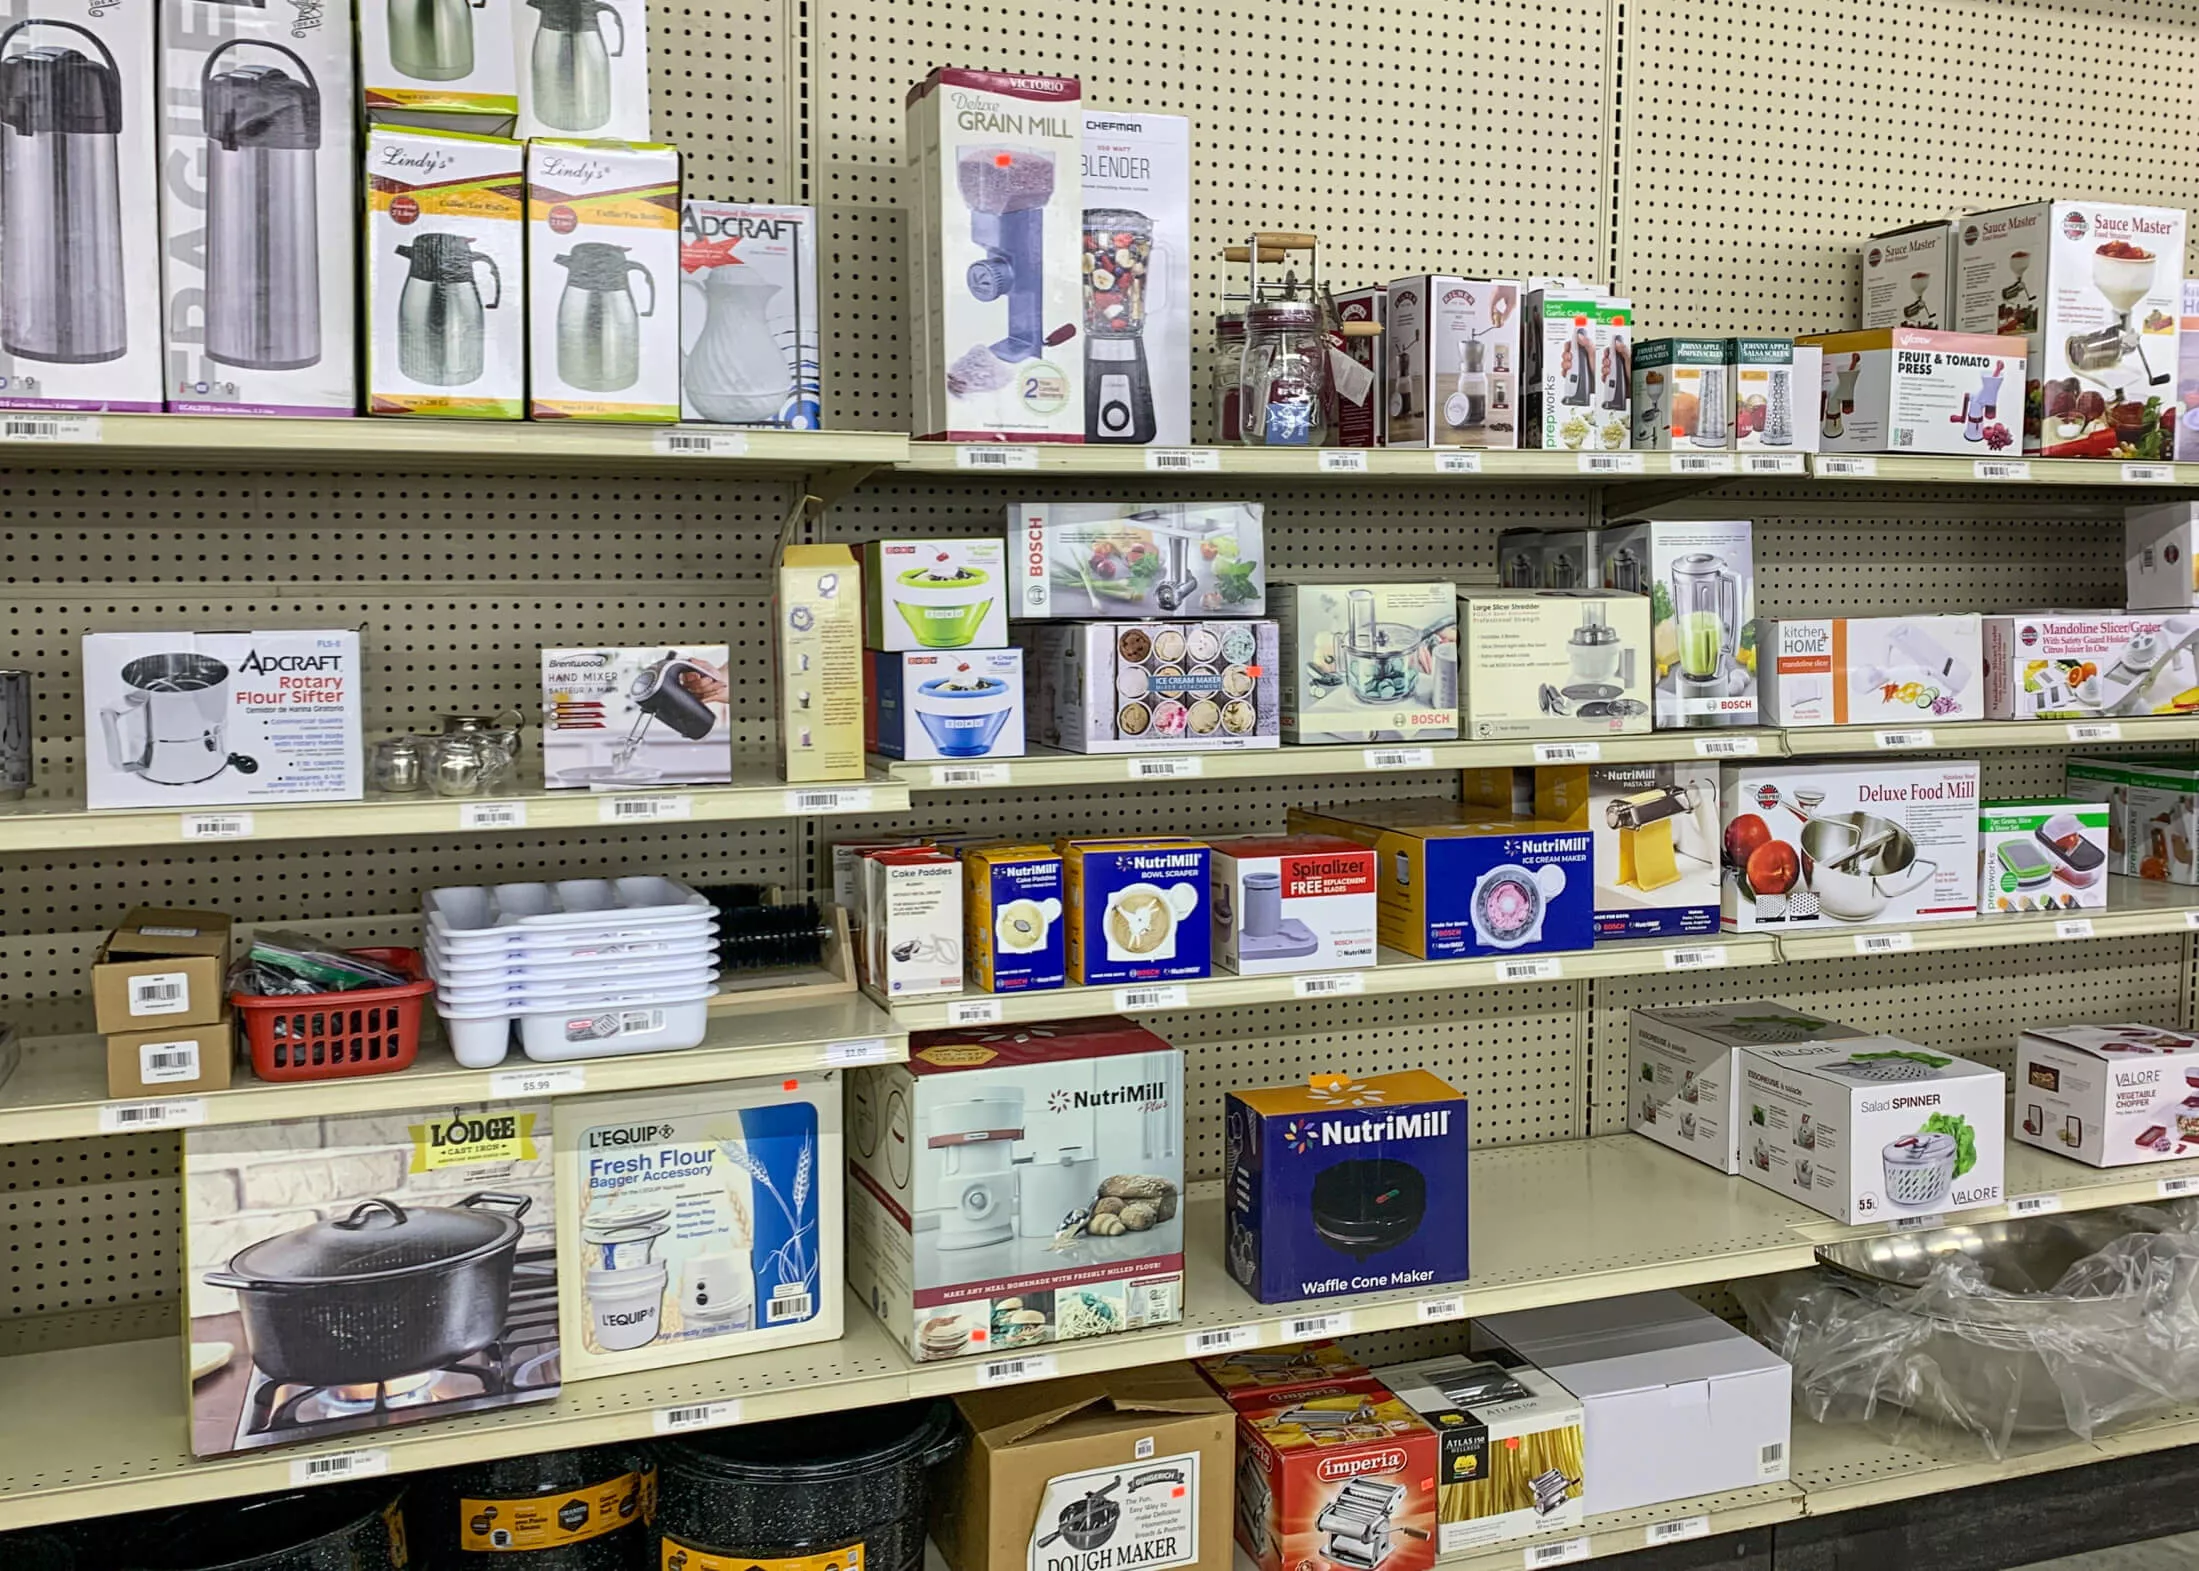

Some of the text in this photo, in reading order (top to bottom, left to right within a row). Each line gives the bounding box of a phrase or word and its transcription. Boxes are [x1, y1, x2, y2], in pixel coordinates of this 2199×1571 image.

[1009, 78, 1064, 92] VICTORIO
[951, 92, 999, 111] Deluxe
[957, 111, 1073, 138] GRAIN MILL
[1086, 120, 1142, 133] CHEFMAN
[1081, 154, 1150, 179] BLENDER
[1982, 215, 2038, 235] Sauce Master
[2094, 213, 2172, 235] Sauce Master
[1885, 241, 1937, 257] Sauce Master
[1770, 343, 1791, 351] APPLE
[1898, 351, 1990, 368] FRUIT & TOMATO
[1898, 362, 1932, 375] PRESS
[1024, 378, 1037, 398] 2
[1546, 374, 1557, 449] prepworks
[1029, 517, 1043, 577] BOSCH
[1472, 603, 1491, 612] Large
[1784, 625, 1825, 639] kitchen
[2042, 622, 2161, 635] Mandoline Slicer/Grater
[1784, 639, 1825, 653] HOME
[2042, 635, 2130, 646] With Safety Guard Holder
[2066, 645, 2084, 653] Juicer
[2085, 645, 2093, 653] In
[239, 649, 343, 676] ADCRAFT
[548, 658, 604, 668] Brentwood
[280, 676, 343, 690] Rotary
[548, 672, 618, 682] HAND MIXER
[236, 690, 344, 704] Flour Sifter
[1721, 699, 1752, 710] BOSCH
[1411, 713, 1450, 725] BOSCH
[1608, 769, 1655, 781] NutriMill
[1859, 781, 1975, 802] Deluxe Food Mill
[1522, 837, 1587, 854] NutriMill
[1134, 854, 1199, 870] NutriMill
[1562, 854, 1587, 862] MAKER
[892, 868, 952, 878] Cake Paddles
[1007, 864, 1057, 877] NutriMill
[1141, 869, 1199, 879] BOWL SCRAPER
[1292, 859, 1364, 880] Spiralizer
[1290, 877, 1367, 896] FREE REPLACEMENT
[1988, 852, 1996, 910] prepworks
[1438, 929, 1461, 937] BOSCH
[1763, 1045, 1840, 1058] VALORE
[1747, 1069, 1803, 1096] ESSOREUSE salade
[2116, 1070, 2161, 1087] VALORE
[523, 1081, 550, 1091] $5.99
[1074, 1081, 1165, 1108] NutriMill
[2116, 1089, 2157, 1099] VEGETABLE
[1143, 1099, 1169, 1113] Plus
[1861, 1093, 1941, 1113] Salad SPINNER
[2116, 1099, 2149, 1109] CHOPPER
[431, 1112, 515, 1147] LODGE
[1321, 1110, 1449, 1147] NutriMill
[590, 1126, 657, 1148] L'EQUIP
[448, 1144, 500, 1155] CAST IRON
[590, 1148, 716, 1177] Fresh Flour
[590, 1165, 713, 1189] Bagger Accessory
[1952, 1186, 1998, 1205] VALORE
[944, 1261, 1162, 1299] MAKE ANY MEAL HOMEMADE WITH FRESHLY MILLED FLOUR!
[1301, 1268, 1435, 1296] Waffle Cone Maker
[602, 1309, 648, 1327] L'EQUIP
[1275, 1386, 1341, 1401] imperia
[1486, 1403, 1522, 1416] ATLAS
[1446, 1437, 1472, 1449] ATLAS
[1323, 1451, 1400, 1476] imperia
[1145, 1503, 1159, 1511] Way
[1135, 1509, 1181, 1521] make Delicious
[1141, 1517, 1178, 1529] Homemade
[1135, 1530, 1155, 1539] Breads
[1164, 1525, 1186, 1533] Pastries
[1047, 1536, 1177, 1571] DOUGH MAKER
